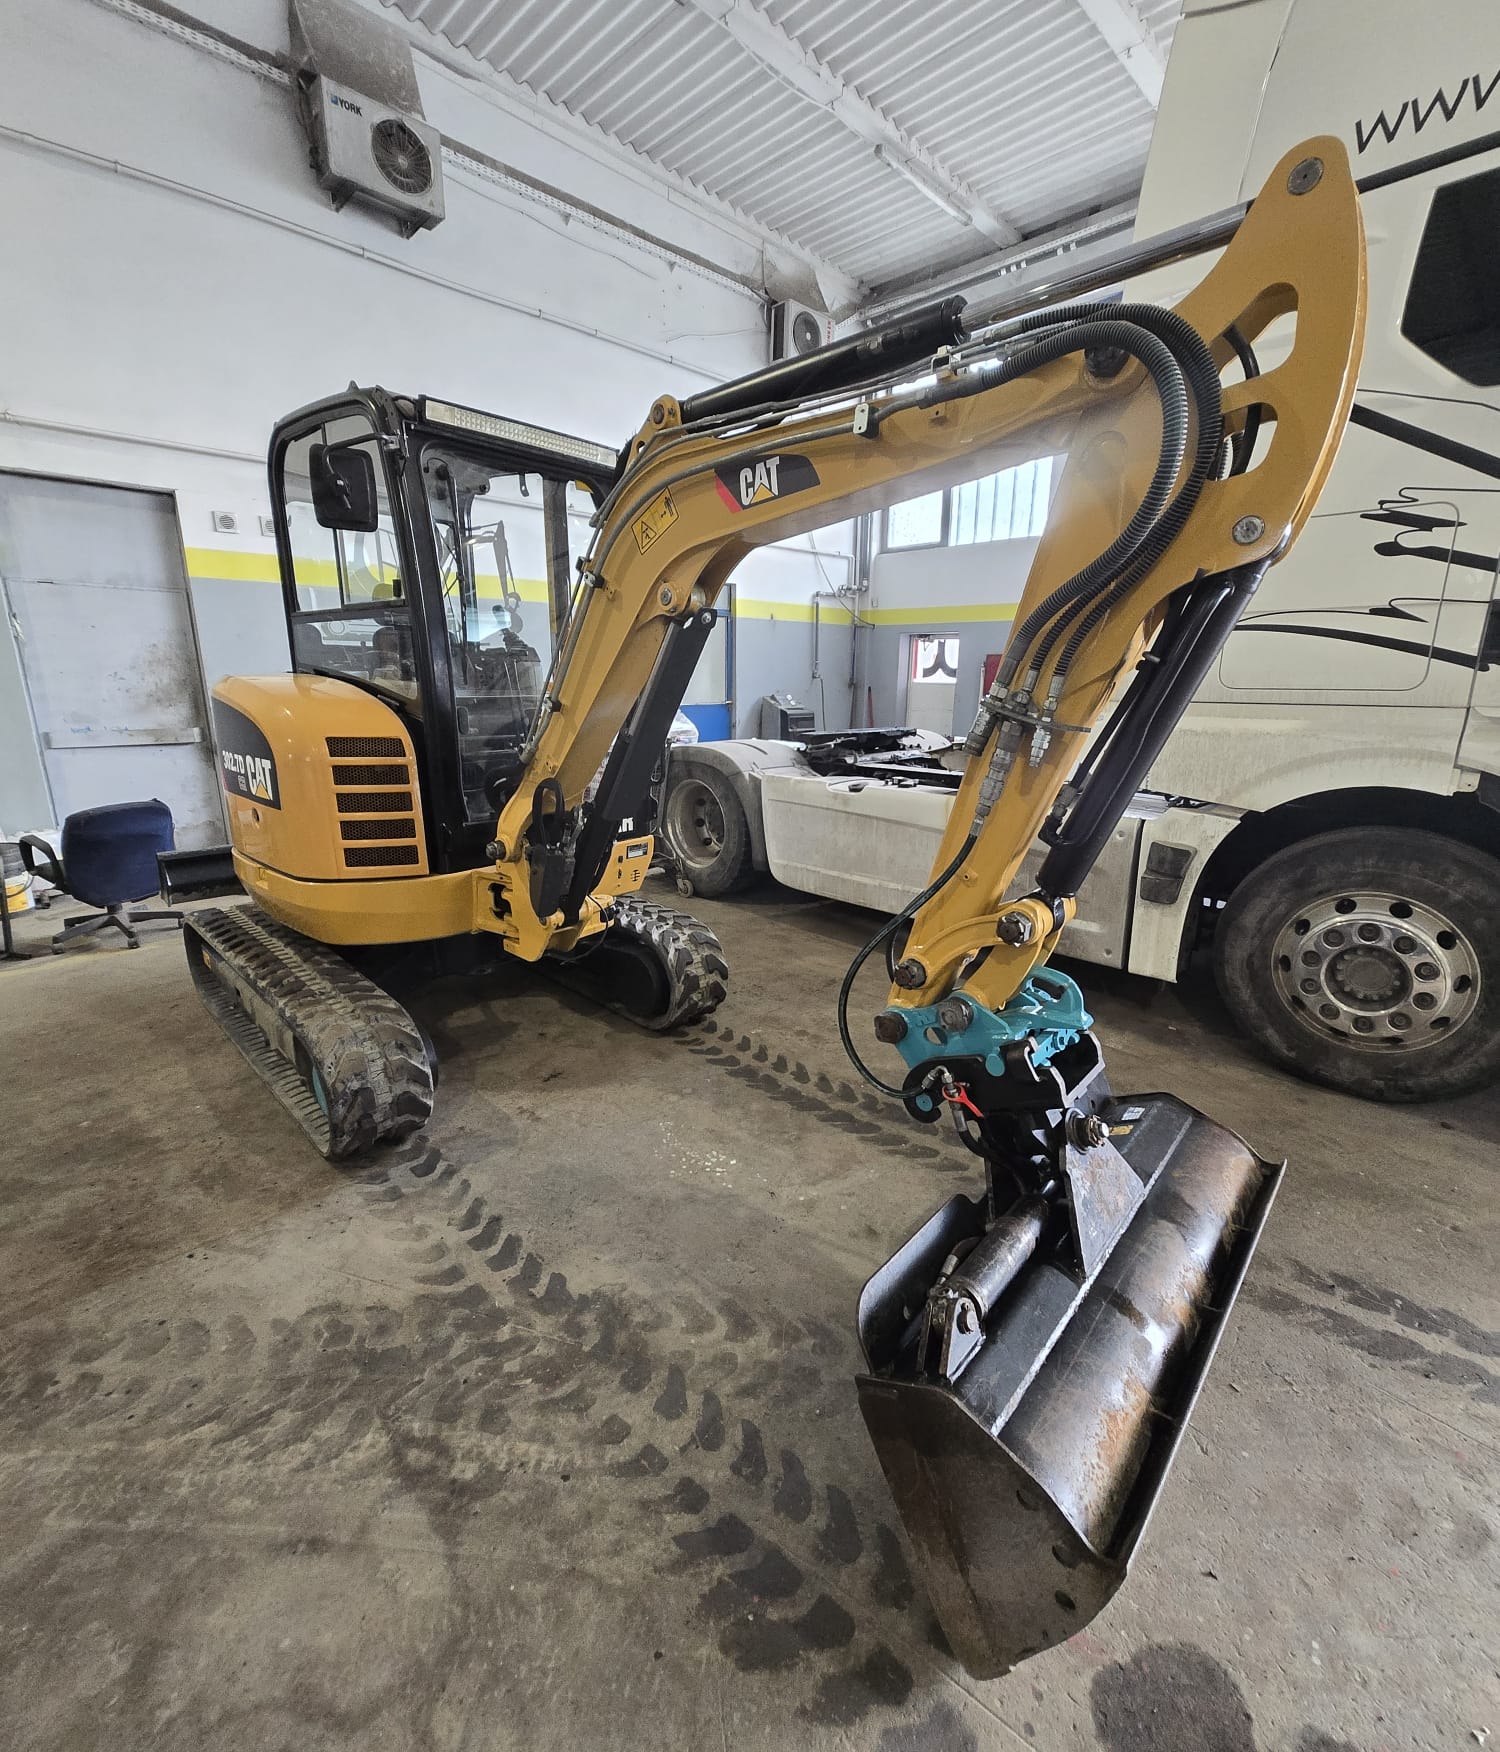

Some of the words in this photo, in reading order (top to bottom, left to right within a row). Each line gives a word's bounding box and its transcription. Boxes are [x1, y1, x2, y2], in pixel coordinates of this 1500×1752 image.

[339, 97, 362, 117] YORK
[740, 456, 780, 506] CAT
[246, 755, 273, 800] CAT
